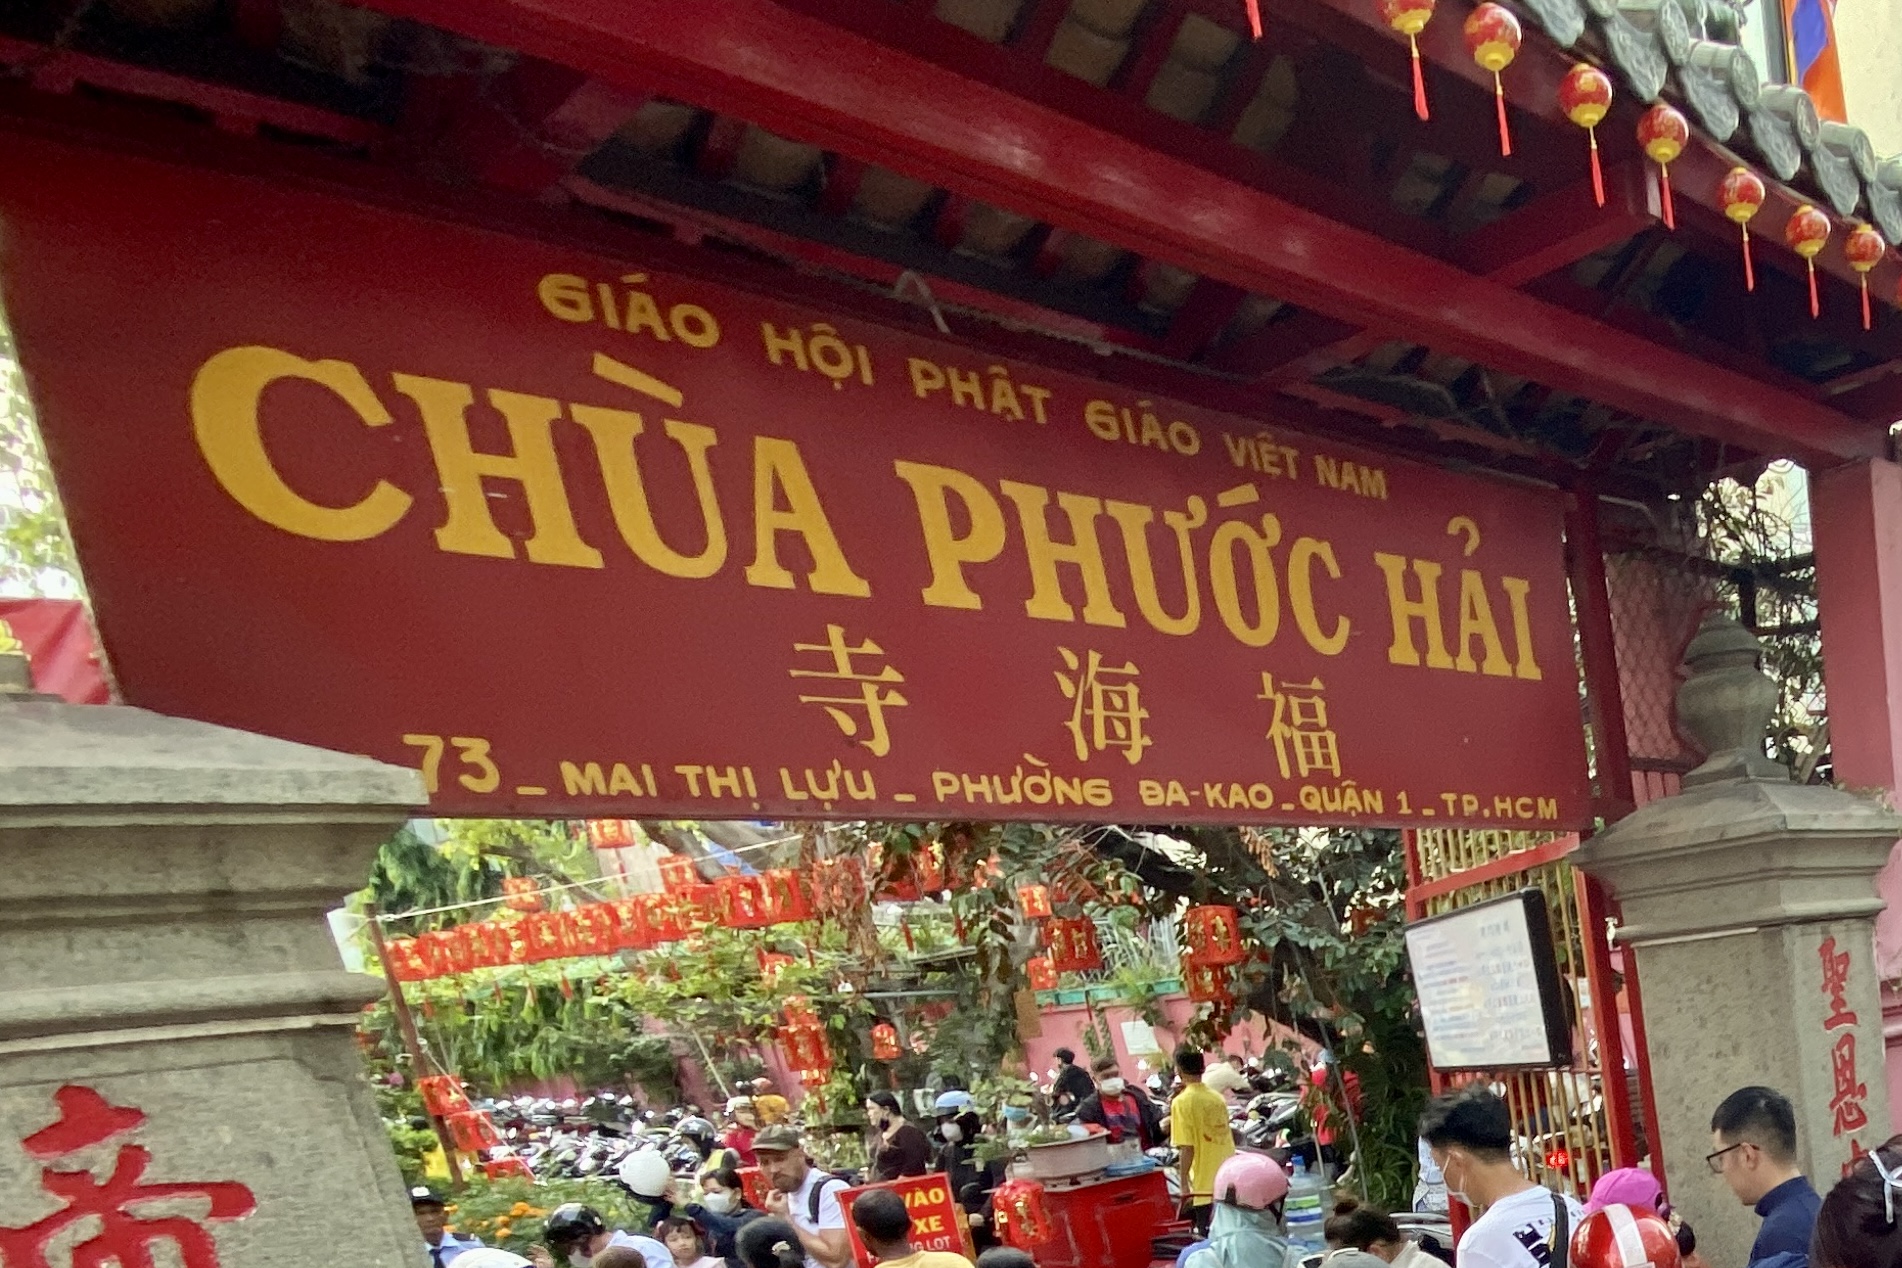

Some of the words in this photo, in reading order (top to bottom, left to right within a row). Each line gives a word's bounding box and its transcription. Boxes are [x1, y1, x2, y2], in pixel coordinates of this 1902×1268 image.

[537, 272, 720, 348] GIÁO
[762, 320, 874, 387] HỘI
[908, 357, 1051, 424] PHẬT
[1084, 399, 1201, 456] GIÁO
[1223, 434, 1299, 477] VIỆT
[1315, 455, 1388, 499] NAM
[189, 345, 873, 599] CHÙA
[894, 459, 1352, 656] PHƯỚC
[1373, 515, 1543, 682] HẢI
[559, 759, 658, 798] MAI
[675, 762, 760, 812] THỊ
[780, 756, 876, 812] LỰU
[932, 752, 1114, 807] PHƯỜNG
[1299, 779, 1385, 818] QUẬN
[1397, 790, 1413, 815] 1
[1440, 792, 1558, 820] TP.HCM
[1818, 936, 1869, 1178] 聖恩
[914, 1215, 945, 1236] XE
[926, 1235, 950, 1251] LOT
